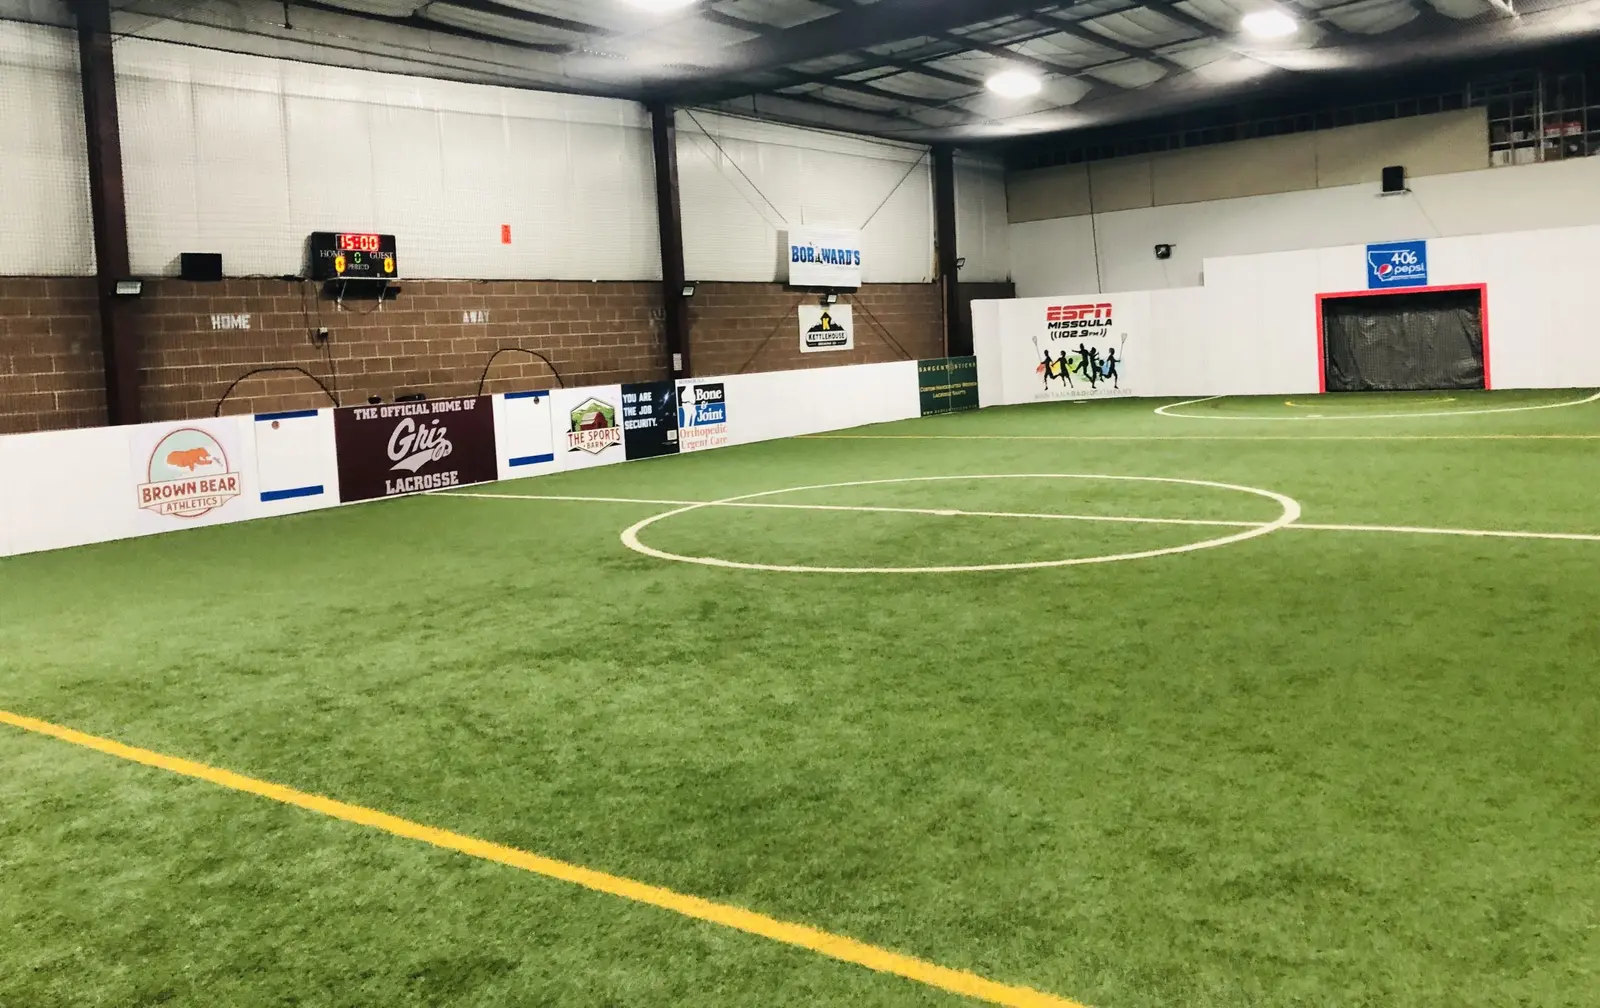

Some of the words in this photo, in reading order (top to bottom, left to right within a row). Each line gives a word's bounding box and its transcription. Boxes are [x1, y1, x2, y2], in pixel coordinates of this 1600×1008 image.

[340, 235, 378, 250] 15:00
[320, 249, 345, 259] HOME
[354, 252, 361, 264] 0
[369, 251, 394, 260] GUEST
[791, 245, 814, 263] BOB
[821, 248, 860, 266] WARD'S
[1391, 251, 1418, 265] 406
[1394, 262, 1424, 275] pepsi
[1046, 302, 1112, 322] ESPN
[210, 314, 251, 330] HOME
[822, 317, 830, 330] K
[1047, 318, 1112, 330] MISSOULA
[808, 332, 845, 341] KETTLEHOUSE
[918, 364, 949, 373] SARGENT
[622, 393, 637, 404] YOU
[639, 391, 652, 402] ARE
[695, 387, 723, 401] Bone
[354, 408, 378, 421] THE
[380, 403, 430, 418] OFFICIAL
[432, 400, 462, 413] HOME
[463, 399, 476, 411] OF
[624, 406, 637, 417] THE
[639, 405, 652, 415] JOB
[700, 400, 708, 410] &
[697, 408, 724, 423] Joint
[624, 418, 658, 431] SECURITY.
[680, 424, 728, 438] Orthopedic
[387, 417, 453, 463] Griz
[568, 432, 585, 447] THE
[588, 427, 621, 442] SPORTS
[681, 440, 707, 450] Urgent
[710, 436, 728, 445] Care
[586, 440, 604, 449] BARN
[385, 470, 459, 495] LACROSSE
[142, 481, 197, 503] BROWN
[199, 477, 236, 493] BEAR
[166, 496, 218, 512] ATHLETICS
